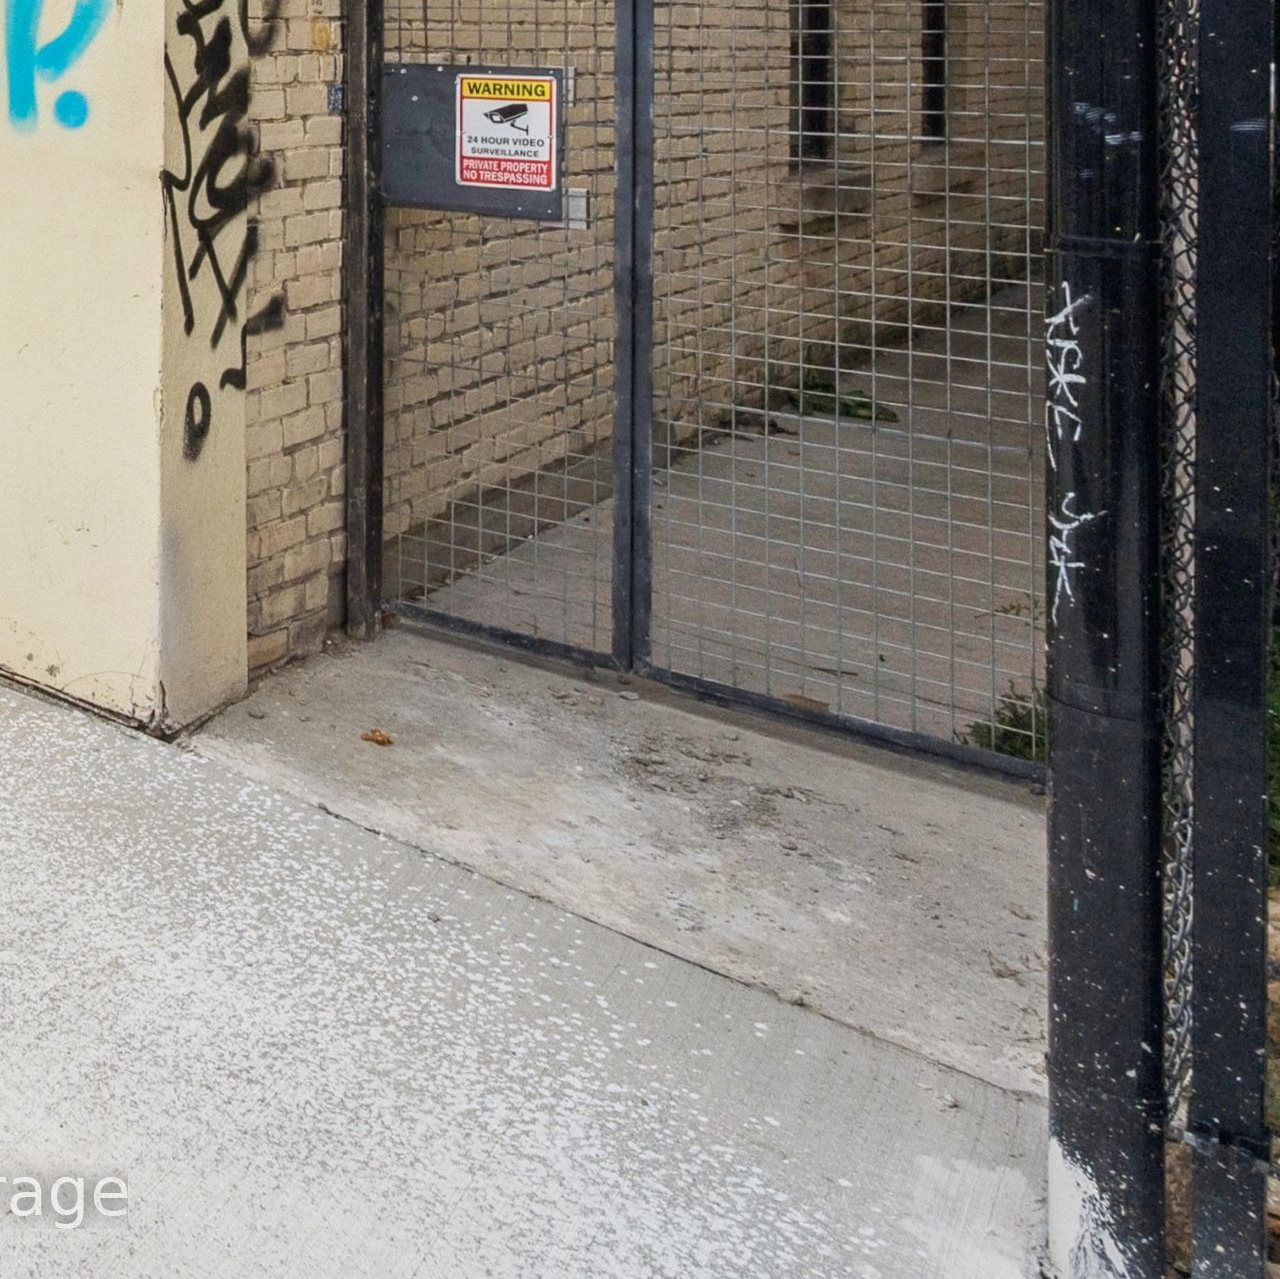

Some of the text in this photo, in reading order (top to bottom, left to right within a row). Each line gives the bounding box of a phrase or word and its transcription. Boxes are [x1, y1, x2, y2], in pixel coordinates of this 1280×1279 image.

[467, 81, 546, 97] WARNING
[467, 136, 545, 147] 24 HOUR VIDEO
[471, 147, 540, 158] SURVEILLANCE
[463, 158, 548, 174] PRIVATE PROPERTY
[463, 170, 548, 185] NO TRESPASSING
